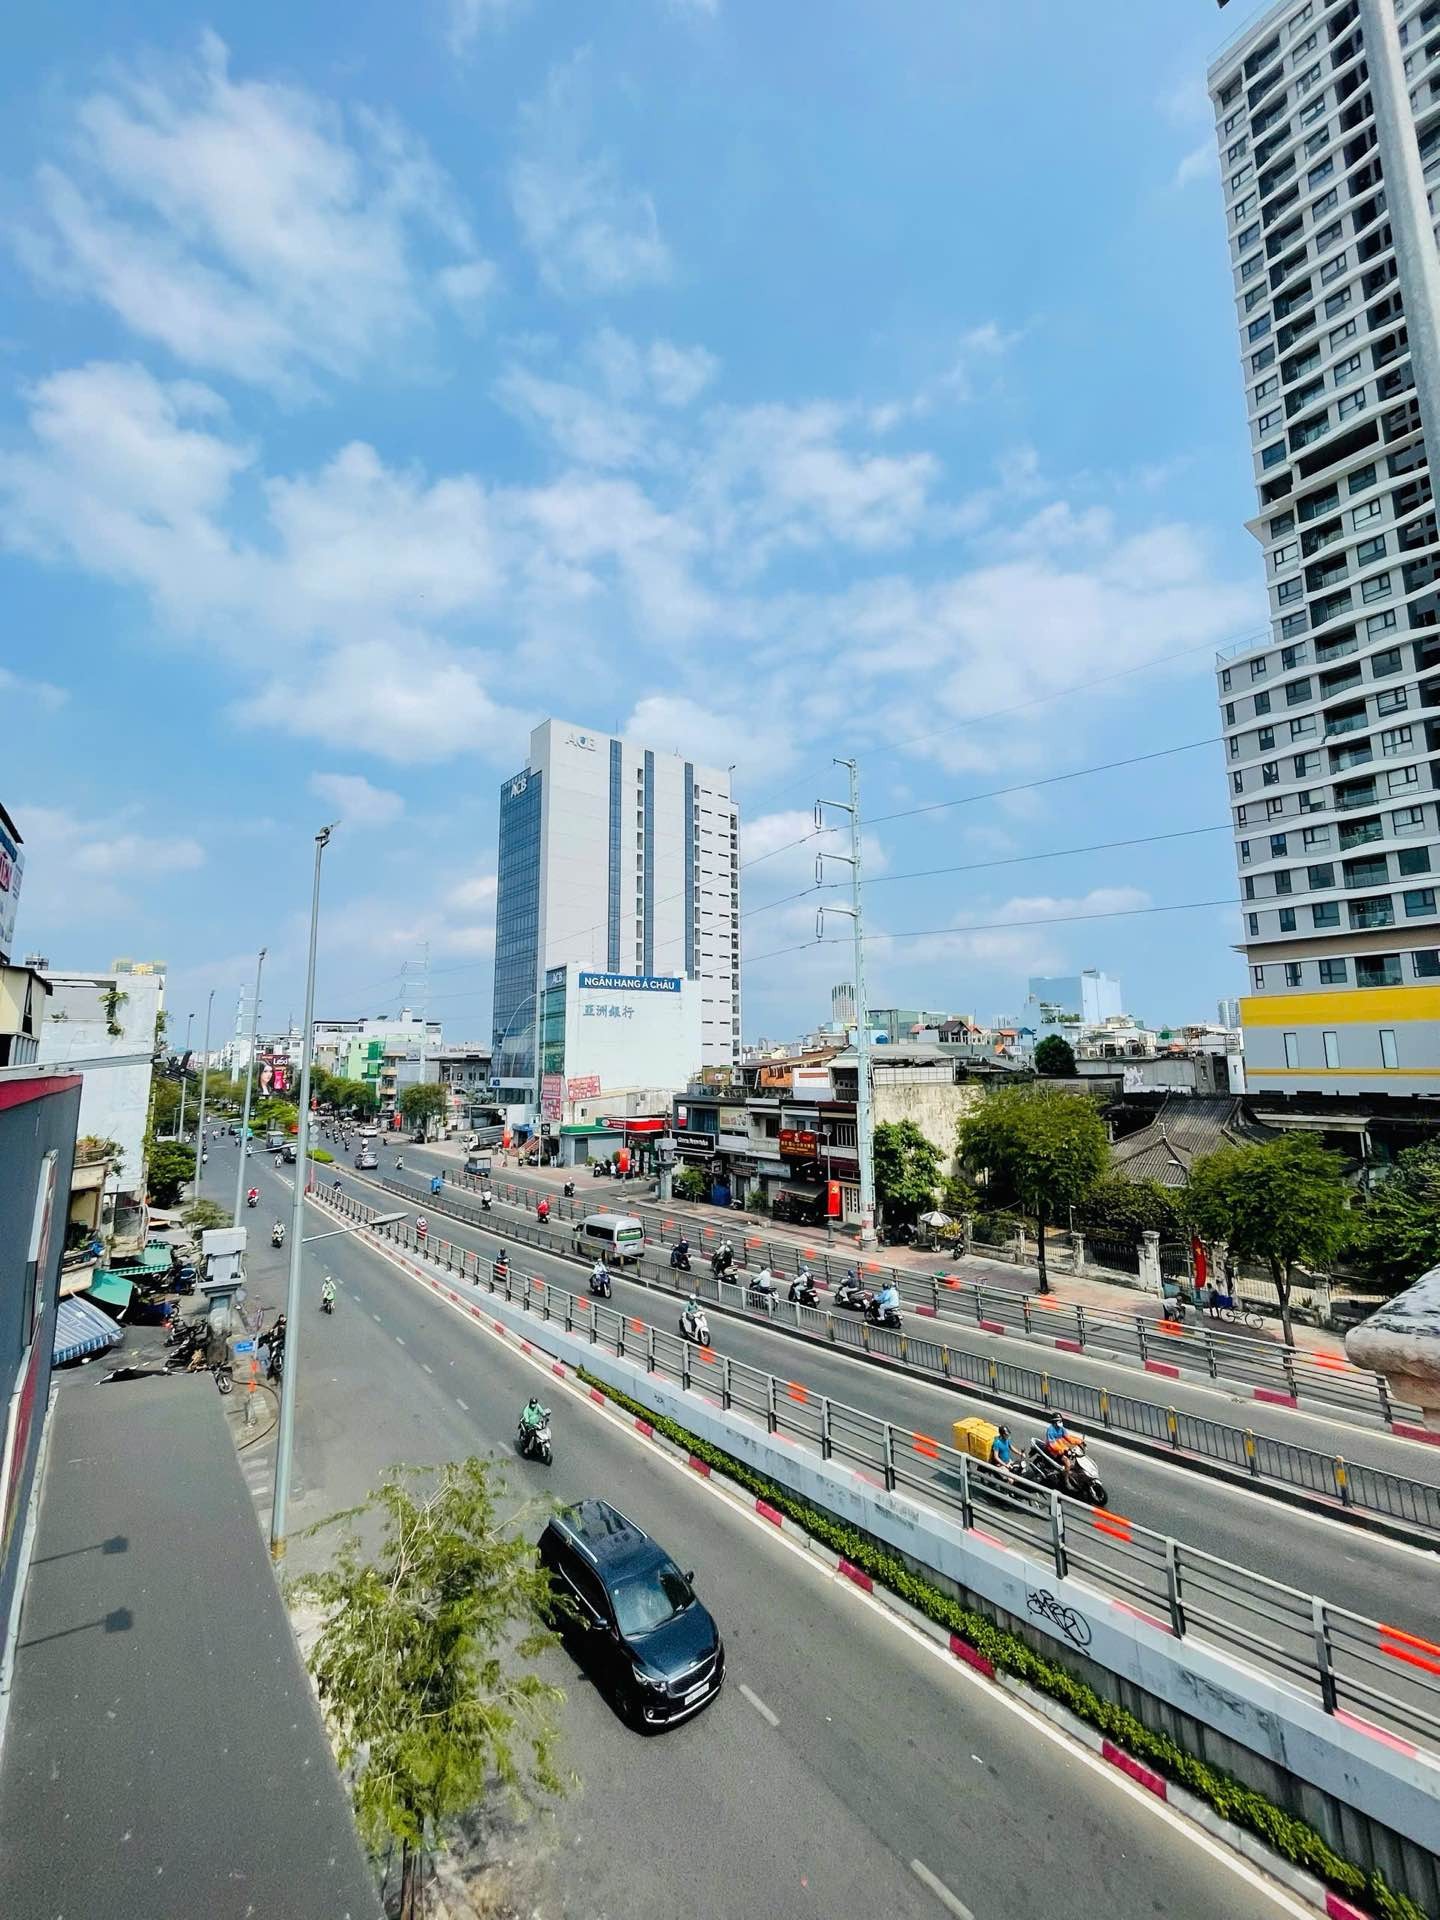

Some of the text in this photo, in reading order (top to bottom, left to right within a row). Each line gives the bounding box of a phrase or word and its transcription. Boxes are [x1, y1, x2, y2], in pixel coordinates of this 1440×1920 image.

[511, 778, 527, 798] ACB
[551, 972, 563, 985] ACB
[584, 976, 612, 987] NGÂN
[649, 979, 675, 990] CHÂU
